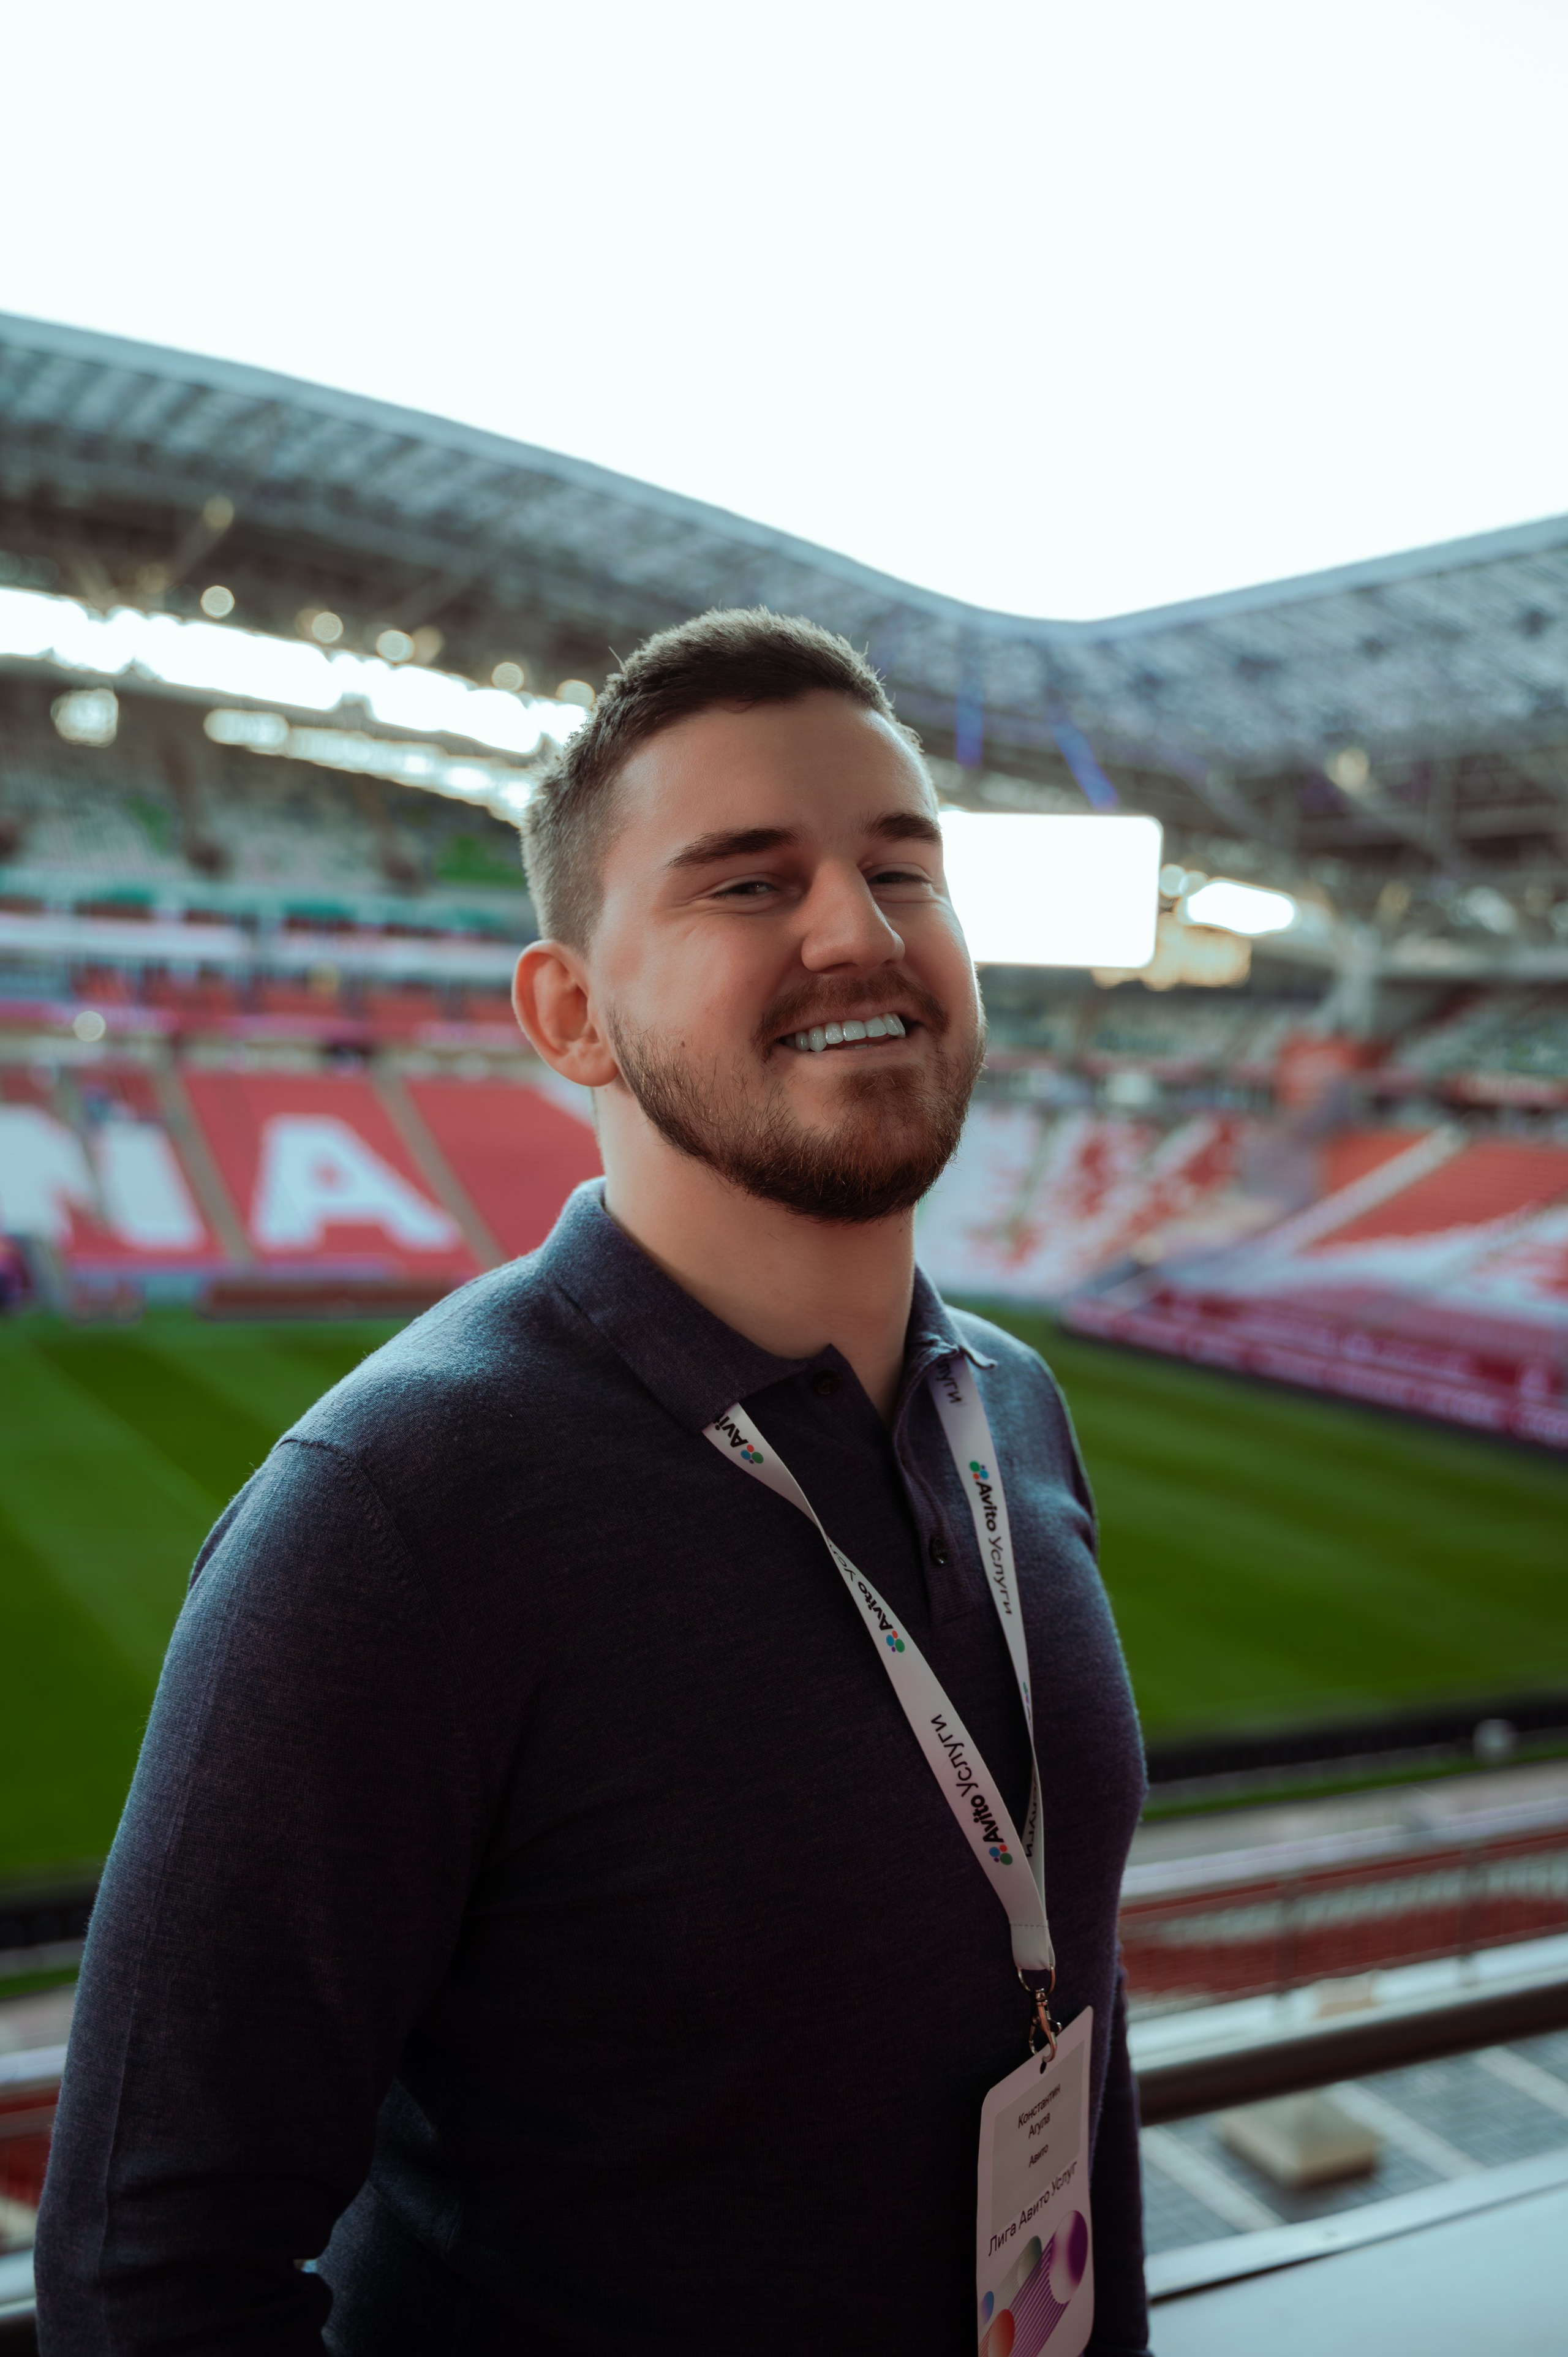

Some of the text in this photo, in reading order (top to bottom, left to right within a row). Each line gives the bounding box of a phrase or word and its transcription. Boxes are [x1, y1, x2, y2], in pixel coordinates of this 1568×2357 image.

[714, 1414, 748, 1447] Avi
[975, 1482, 1013, 1615] Avito Услуги
[858, 1581, 894, 1631] Avito
[930, 1714, 1005, 1842] Avito Услуги
[1018, 2084, 1061, 2129] Константин
[1028, 2144, 1049, 2168] Авито
[988, 2161, 1077, 2257] Лига Авито Услуг
